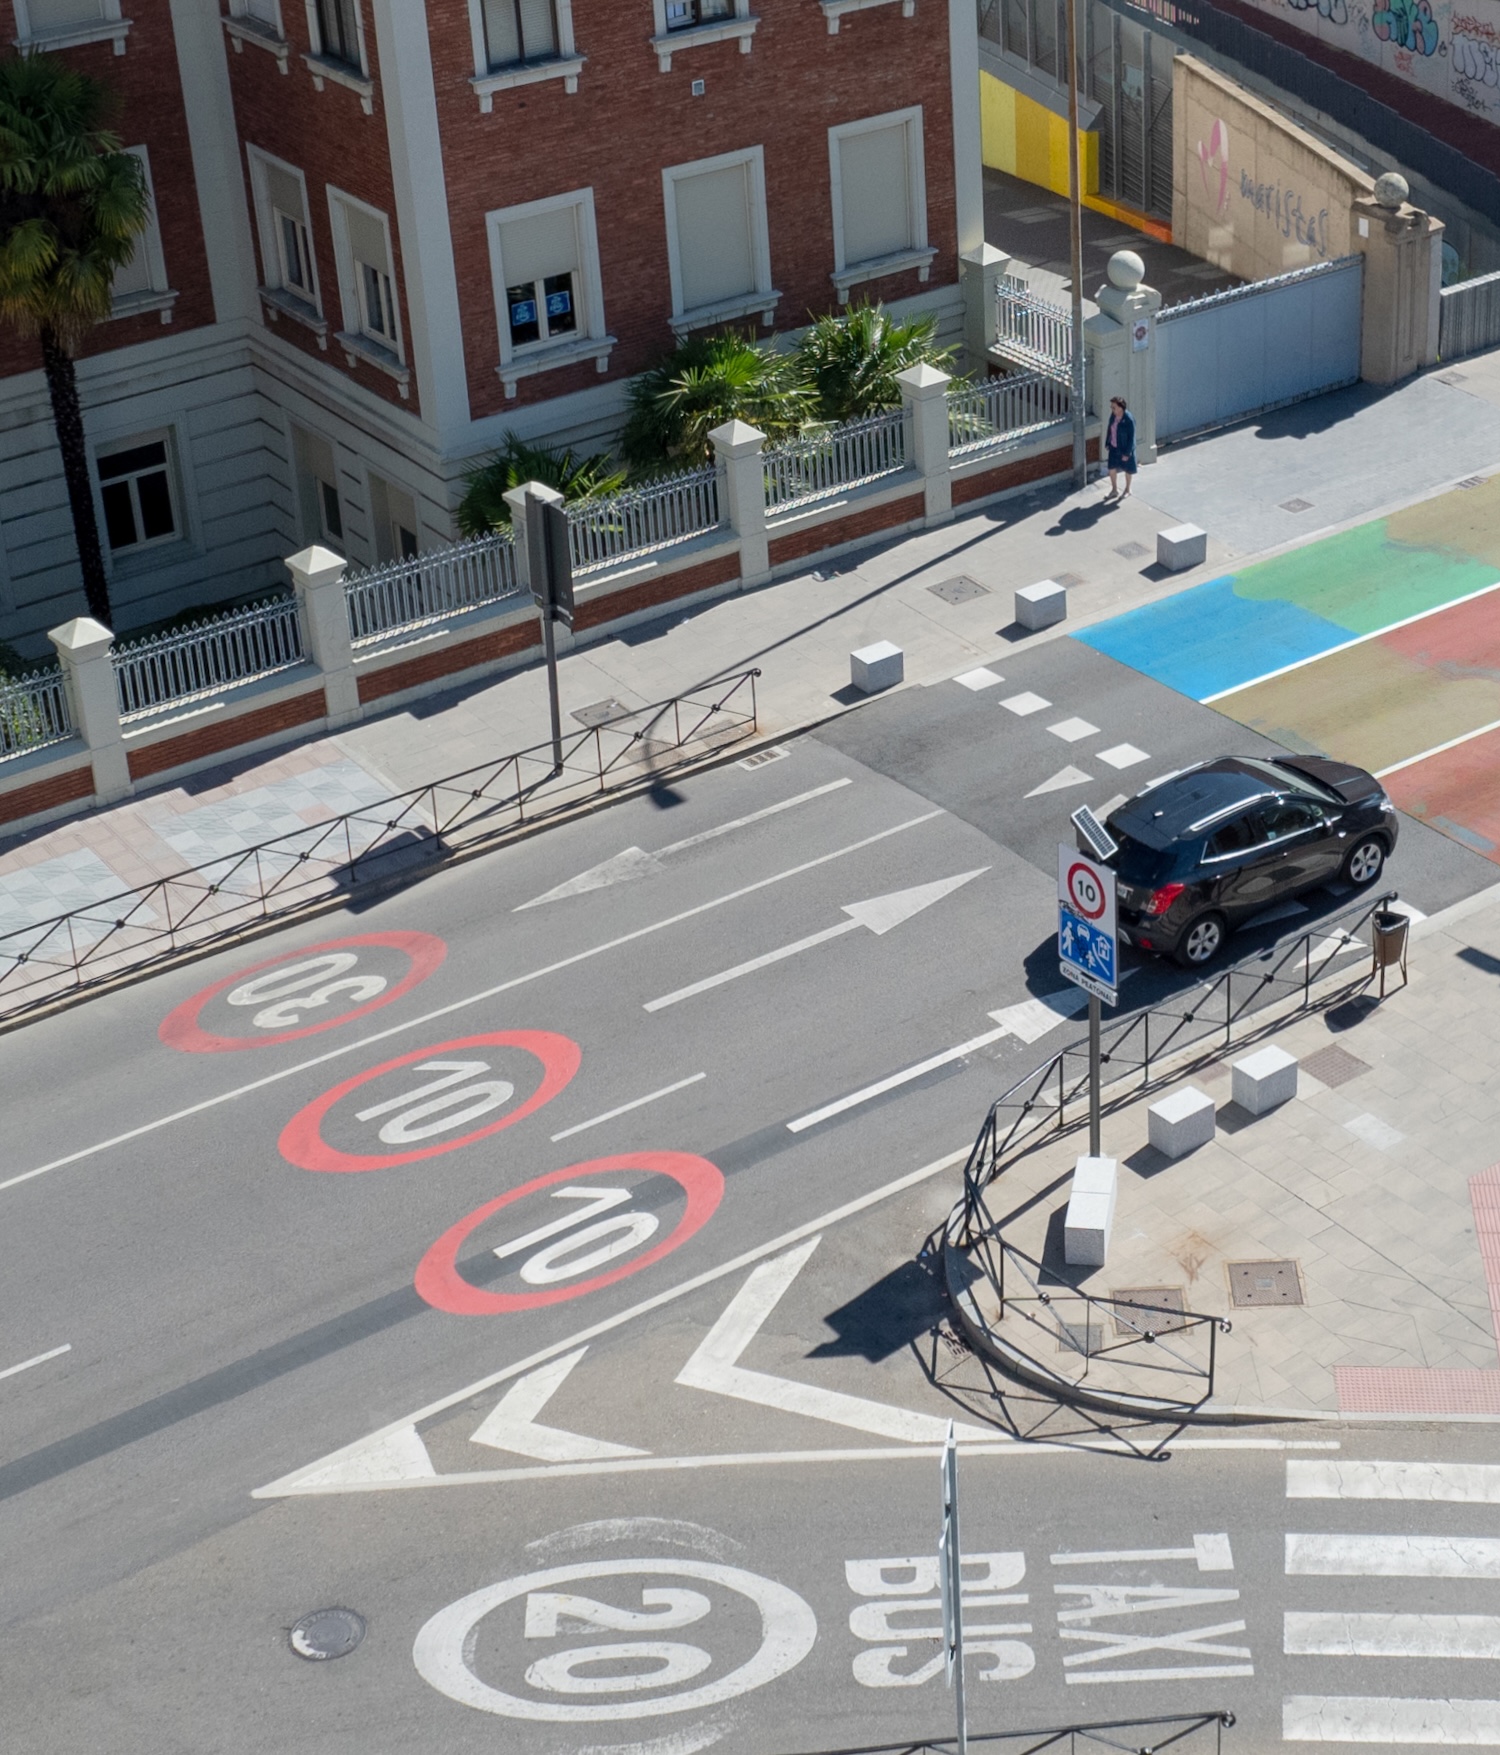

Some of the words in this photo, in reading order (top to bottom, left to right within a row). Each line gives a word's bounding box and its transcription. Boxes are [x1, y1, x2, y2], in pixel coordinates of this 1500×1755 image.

[1078, 880, 1095, 902] 10
[227, 953, 387, 1029] 30
[1063, 967, 1079, 983] ZONA
[1081, 978, 1113, 1002] PEATONAL
[355, 1061, 514, 1145] 10
[494, 1187, 660, 1284] 10
[524, 1588, 711, 1693] 20
[845, 1552, 1035, 1687] BUS
[1050, 1533, 1254, 1684] TAXI
